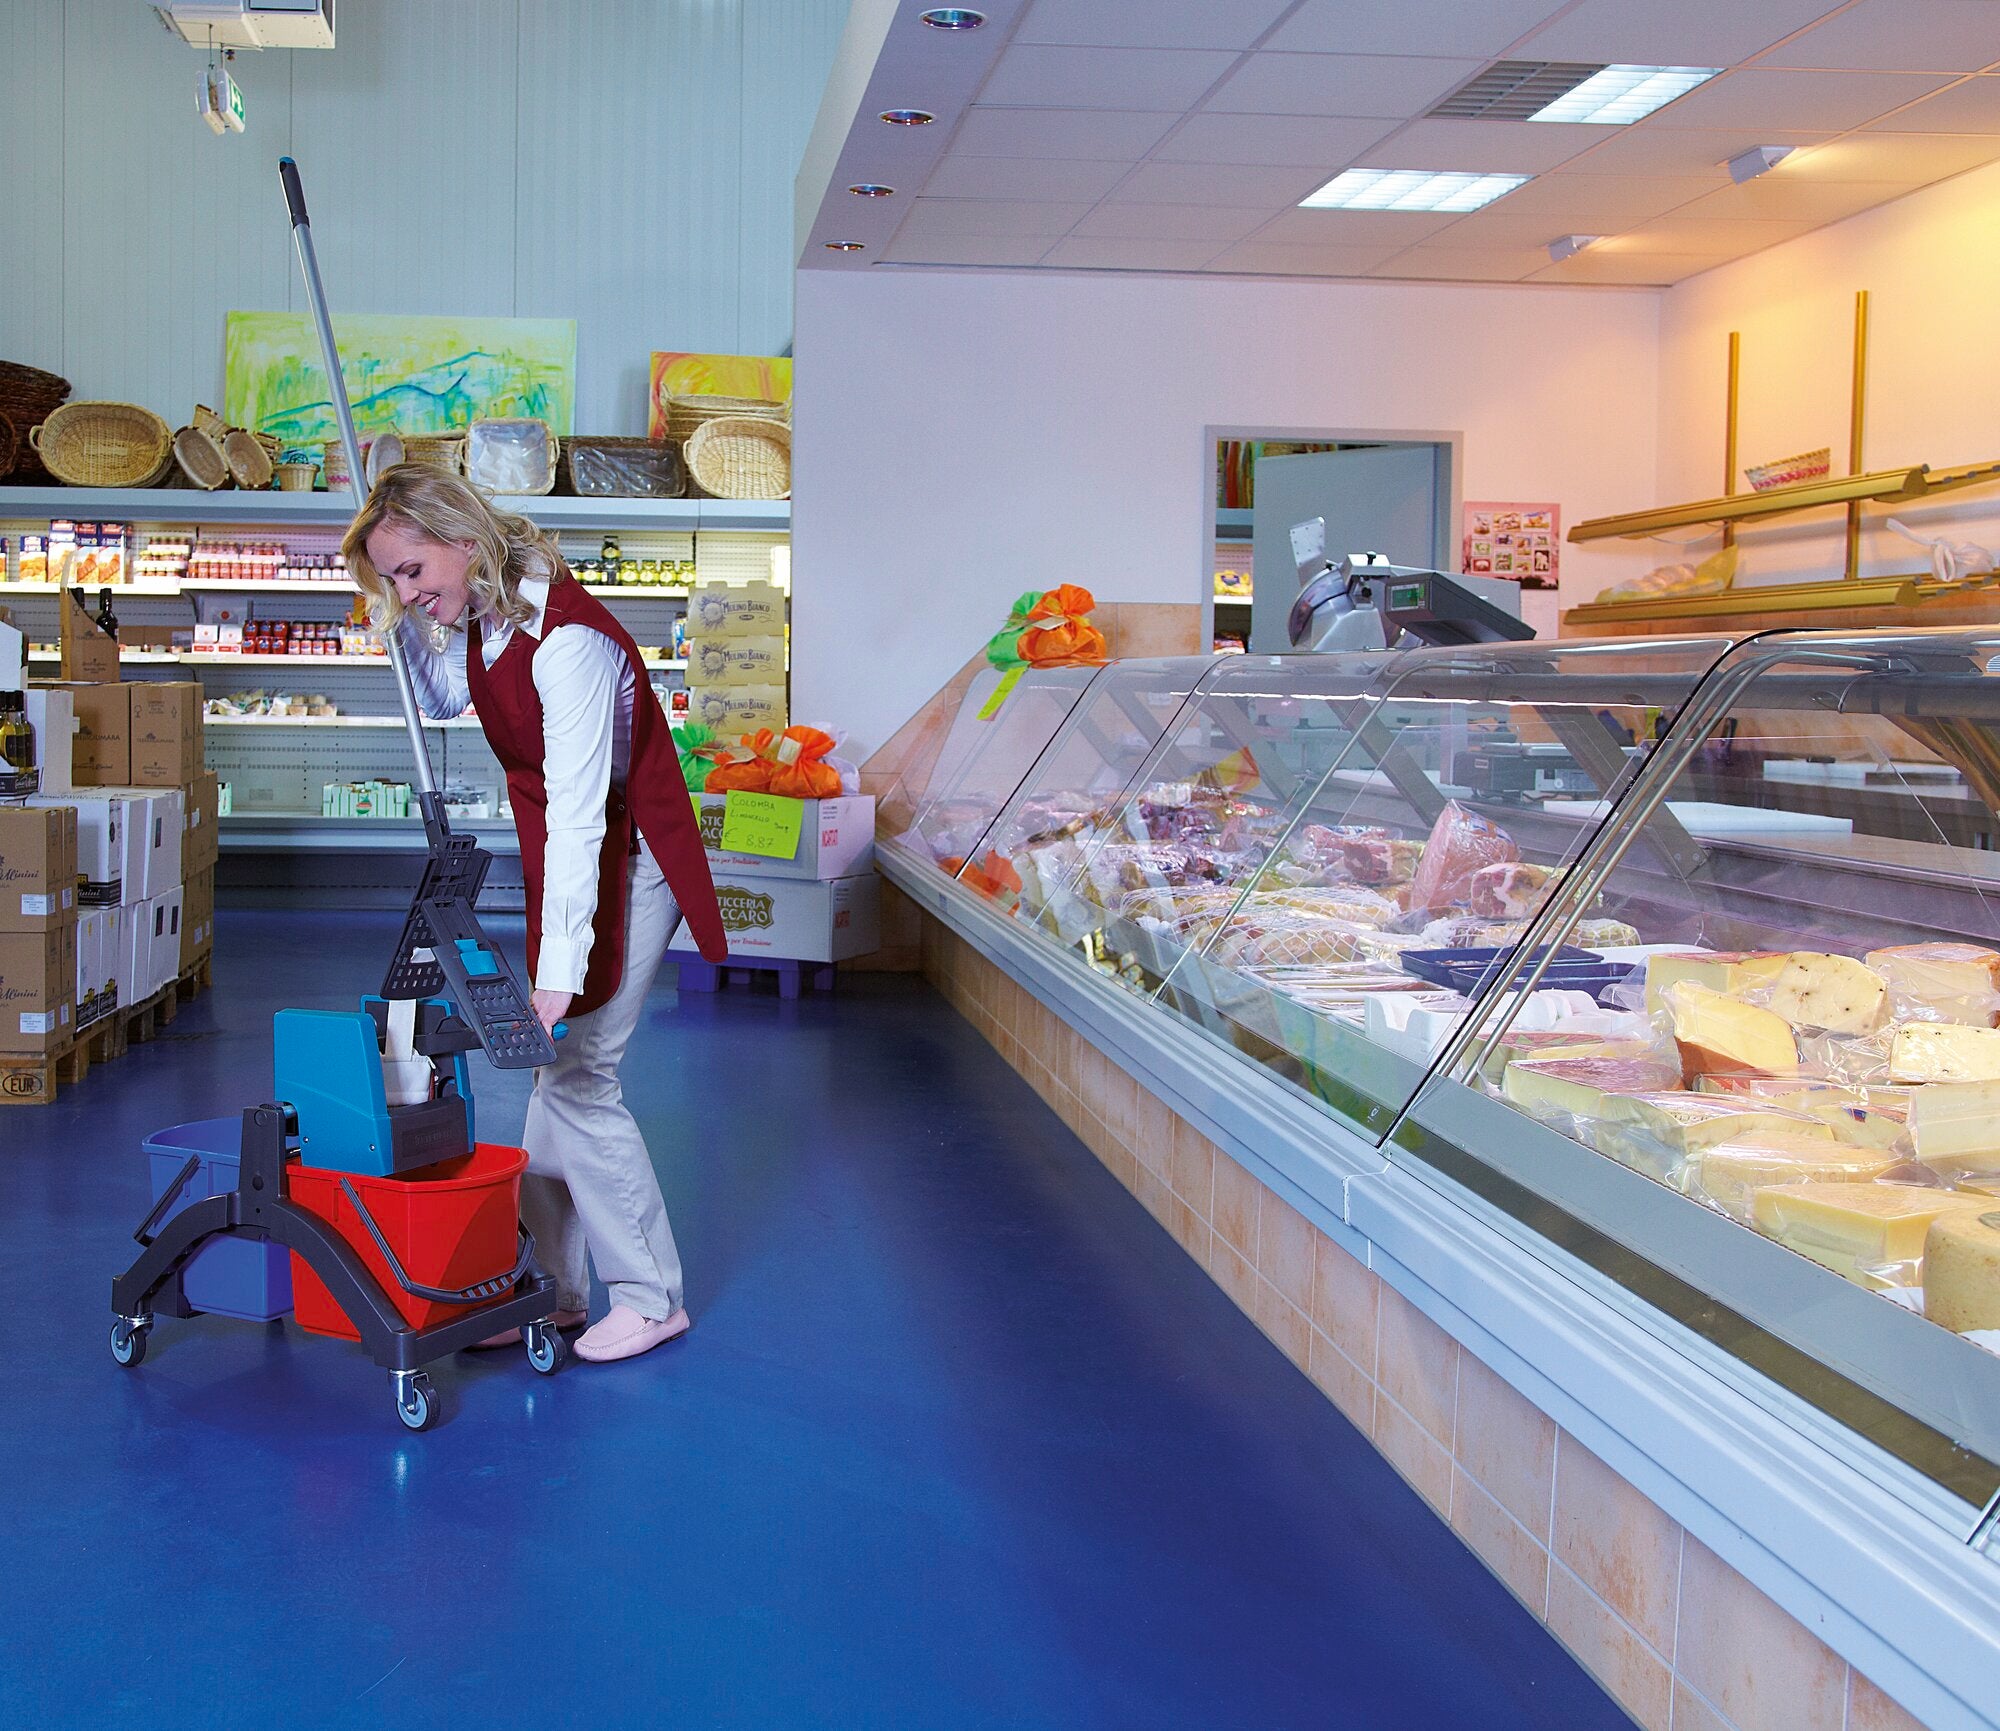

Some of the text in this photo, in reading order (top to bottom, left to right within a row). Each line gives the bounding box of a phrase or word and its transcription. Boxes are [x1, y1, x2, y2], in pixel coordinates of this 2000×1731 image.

[722, 600, 770, 613] MULINO BIANCO
[723, 648, 771, 662] MULINO BIANCO
[724, 698, 771, 711] MULINO BIANCO
[731, 794, 776, 810] COLOMBA
[724, 827, 739, 843] €
[746, 833, 774, 848] 8,87
[716, 896, 766, 910] TICCERIA
[719, 907, 769, 924] CCARO
[10, 1077, 34, 1093] EUR
